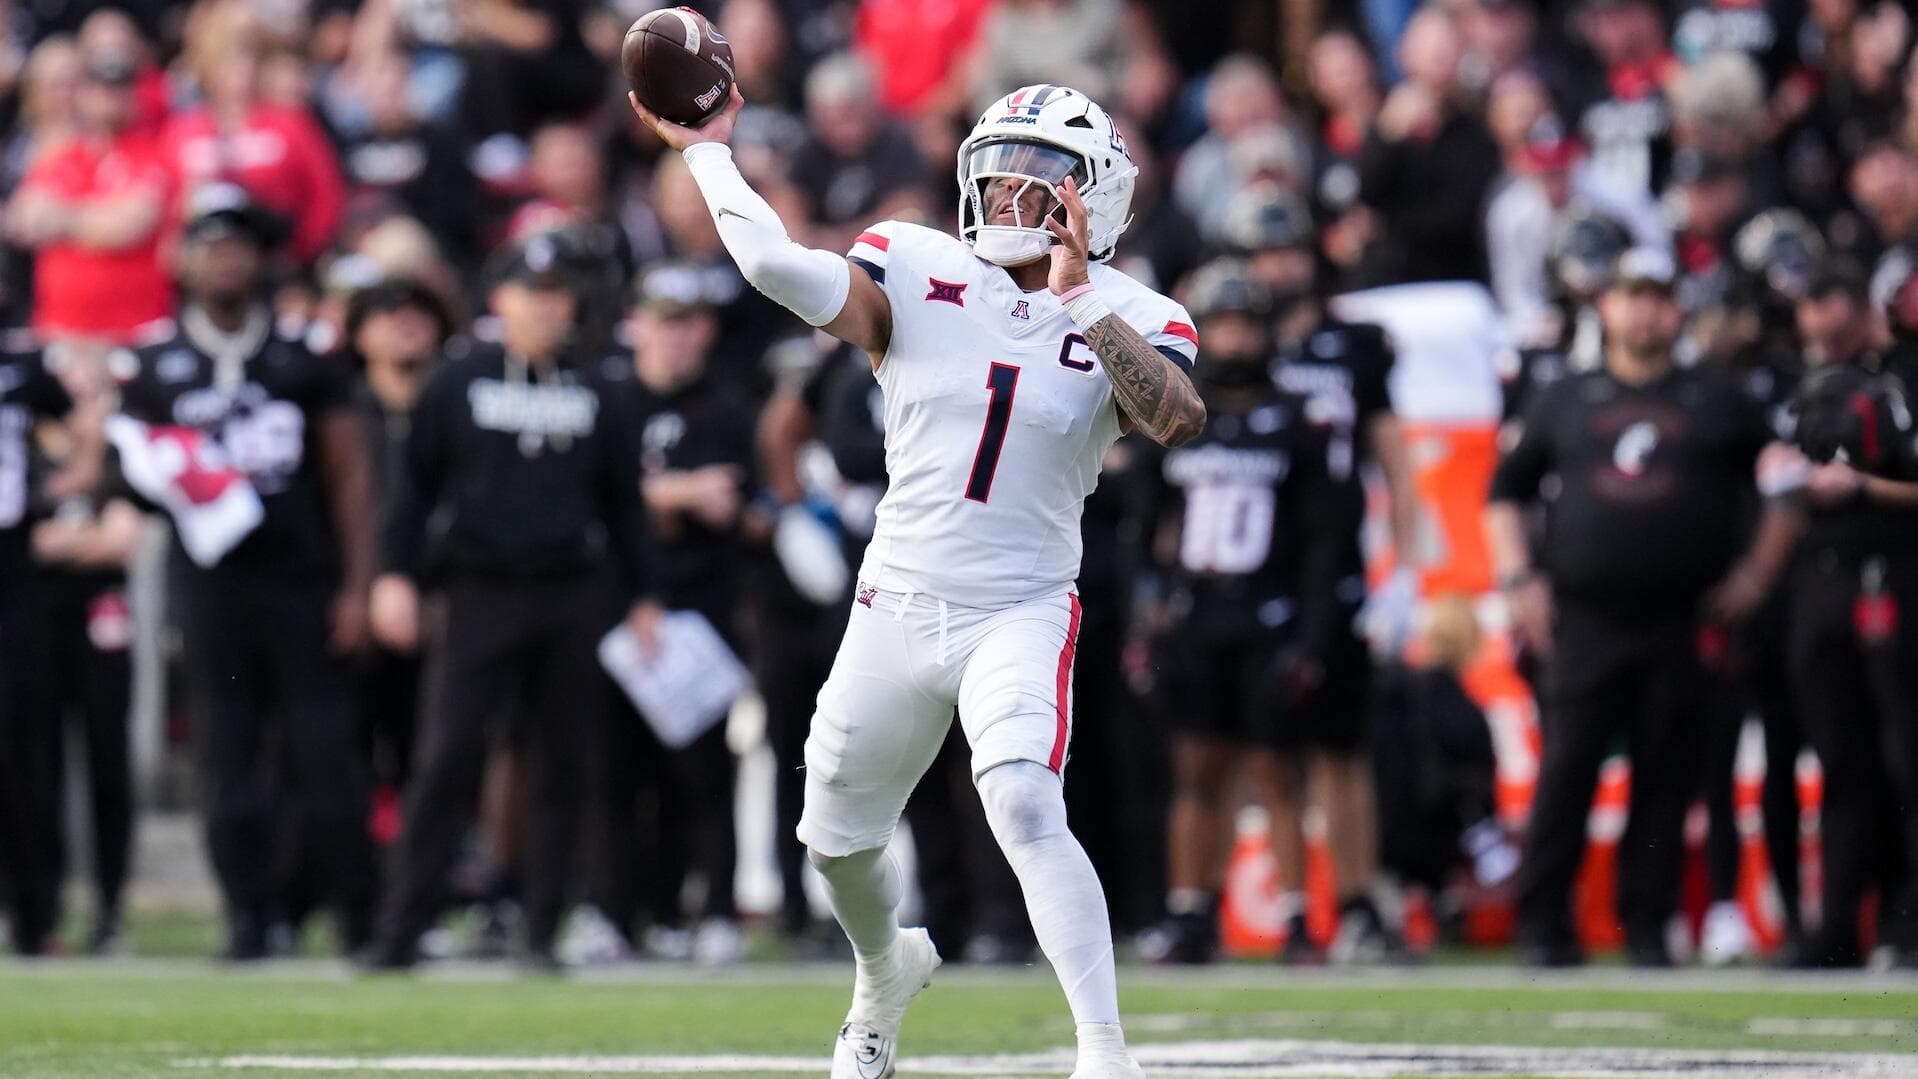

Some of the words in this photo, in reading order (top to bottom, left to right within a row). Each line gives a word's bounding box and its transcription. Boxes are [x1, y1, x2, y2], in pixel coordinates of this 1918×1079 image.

[996, 115, 1037, 126] ARIZONA
[924, 276, 968, 307] XII
[1011, 300, 1030, 319] A
[1058, 332, 1096, 373] C
[964, 361, 1021, 504] 1
